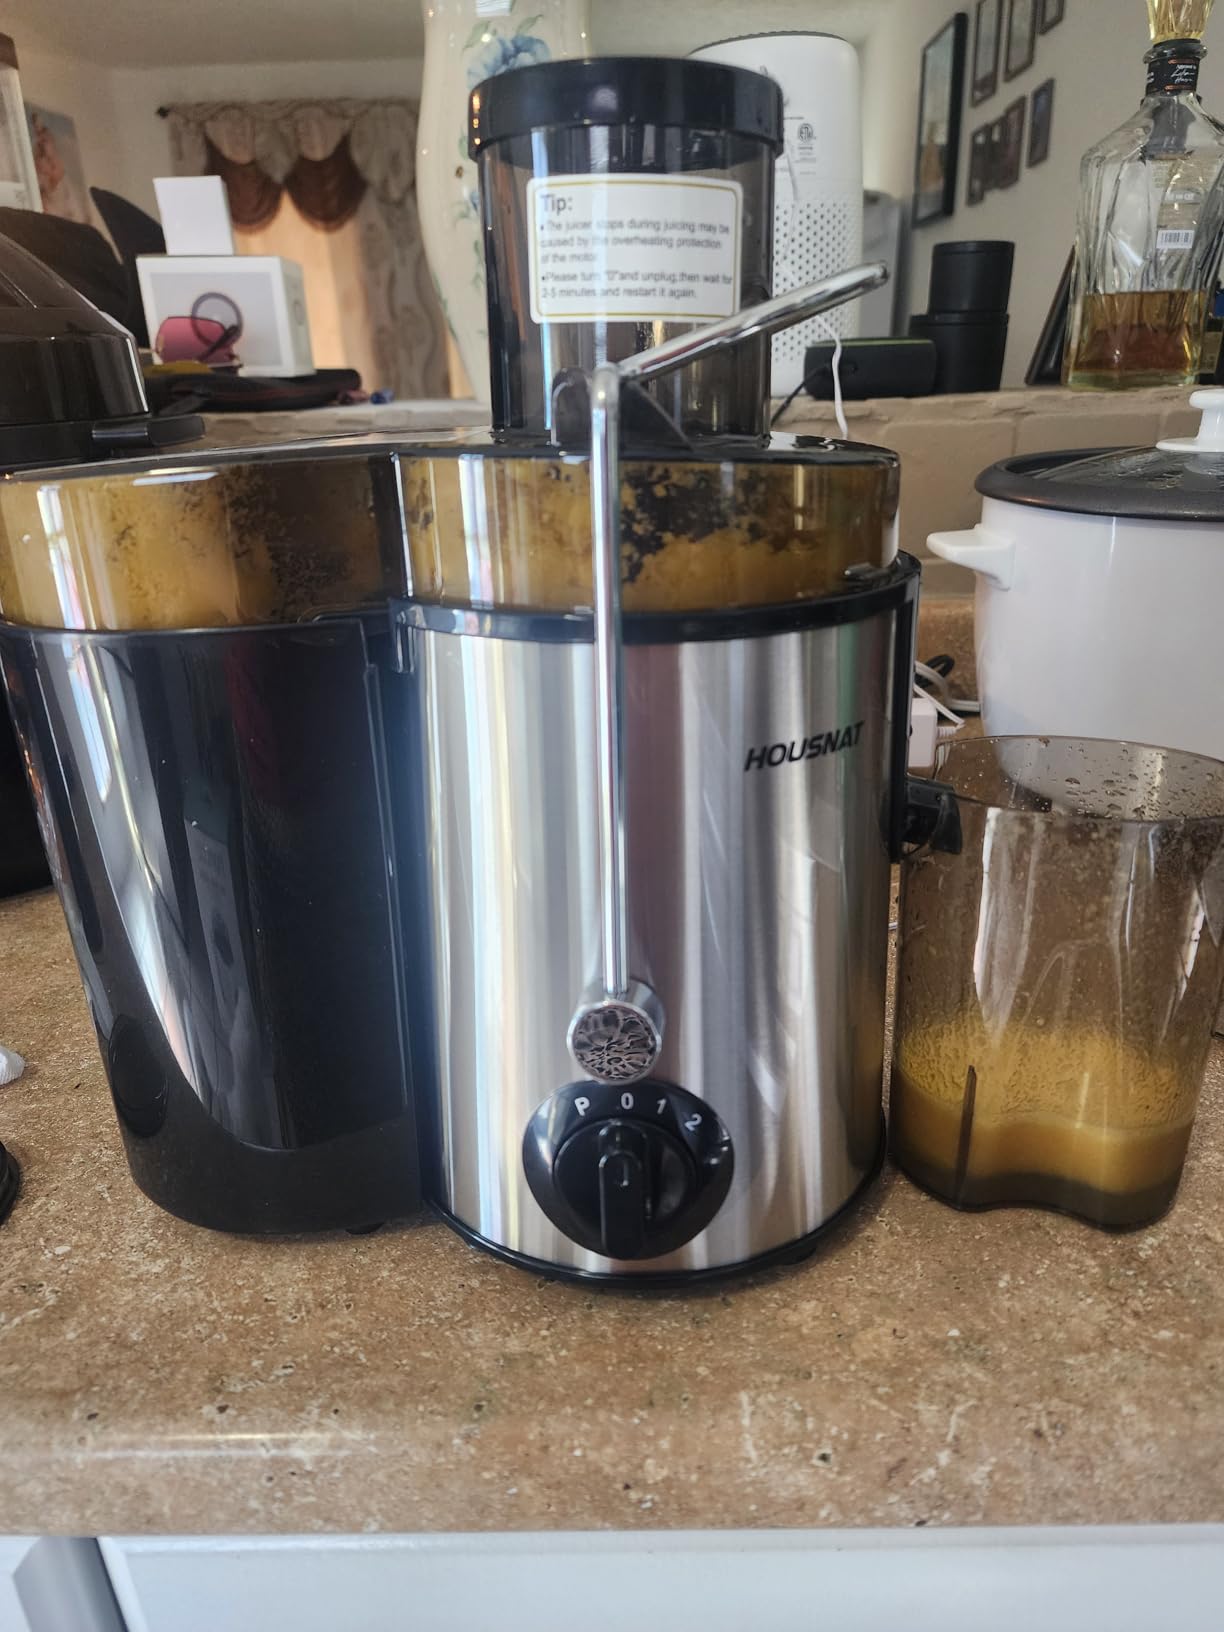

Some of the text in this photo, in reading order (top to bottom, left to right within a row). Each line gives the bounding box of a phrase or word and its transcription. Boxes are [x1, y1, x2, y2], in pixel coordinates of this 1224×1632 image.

[541, 193, 573, 216] Tip:
[565, 221, 593, 232] juicer
[628, 219, 661, 232] during
[664, 220, 697, 234] juicing
[699, 222, 718, 235] may
[719, 224, 730, 235] be
[540, 237, 575, 249] caused
[577, 237, 589, 249] by
[612, 236, 674, 249] overheating
[541, 253, 550, 264] of
[552, 252, 567, 263] the
[703, 272, 720, 284] wait
[722, 274, 733, 285] for
[541, 287, 556, 299] 2-5
[559, 286, 597, 297] minutes
[600, 286, 620, 297] and
[623, 286, 657, 297] restart
[659, 286, 666, 297] it
[744, 720, 866, 772] HOUSNAT
[574, 1092, 703, 1132] P 0 1 2
